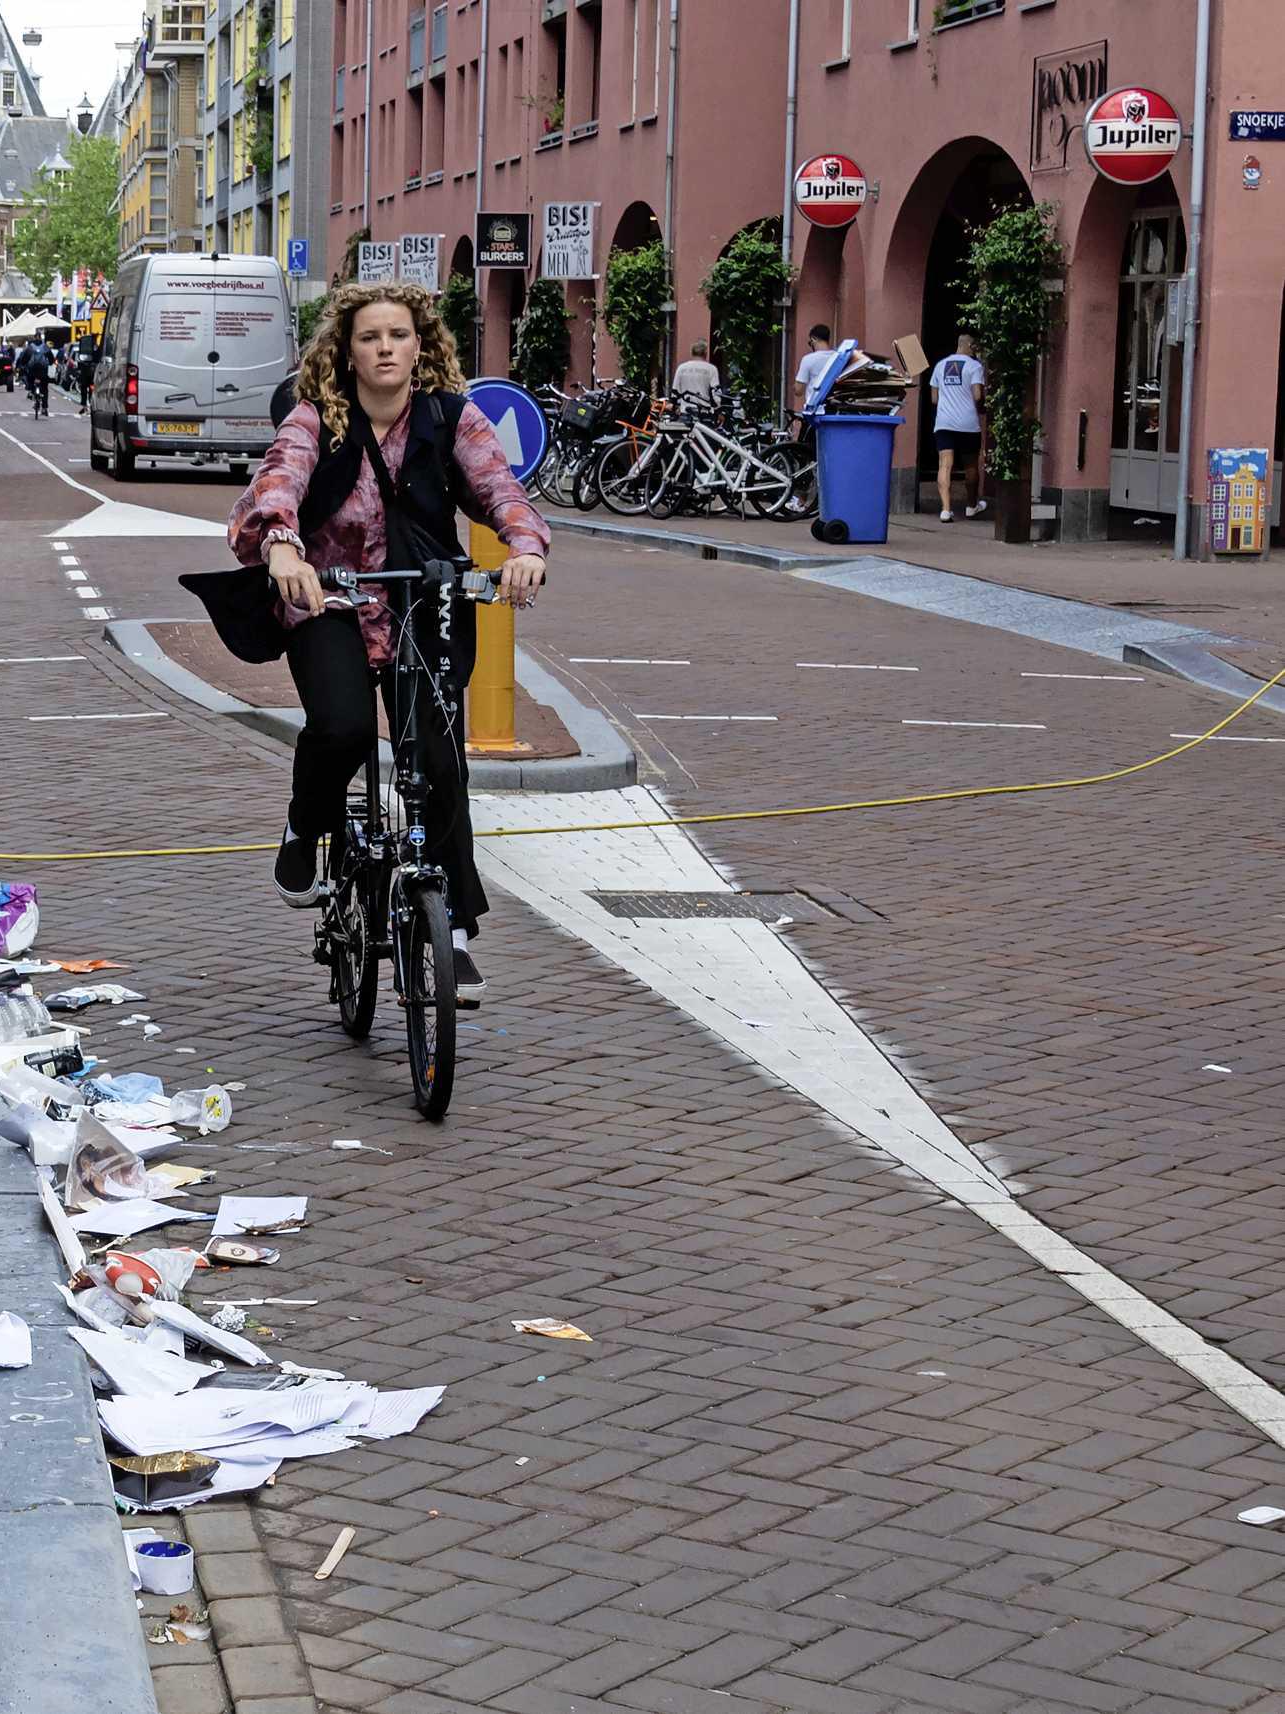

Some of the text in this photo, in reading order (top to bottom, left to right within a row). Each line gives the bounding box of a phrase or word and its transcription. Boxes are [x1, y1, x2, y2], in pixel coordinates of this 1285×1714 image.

[1236, 113, 1285, 130] SNOEKJE
[1093, 124, 1177, 149] Jupiler
[801, 181, 864, 201] Jupiler
[547, 205, 589, 227] BIS!
[362, 244, 392, 260] BIS!
[403, 236, 434, 254] BIS!
[490, 242, 515, 252] STARS
[480, 251, 524, 262] BURGERS
[547, 252, 569, 277] MEN
[404, 267, 421, 276] FOR
[166, 279, 265, 291] www.voegbedrijfbos.nl
